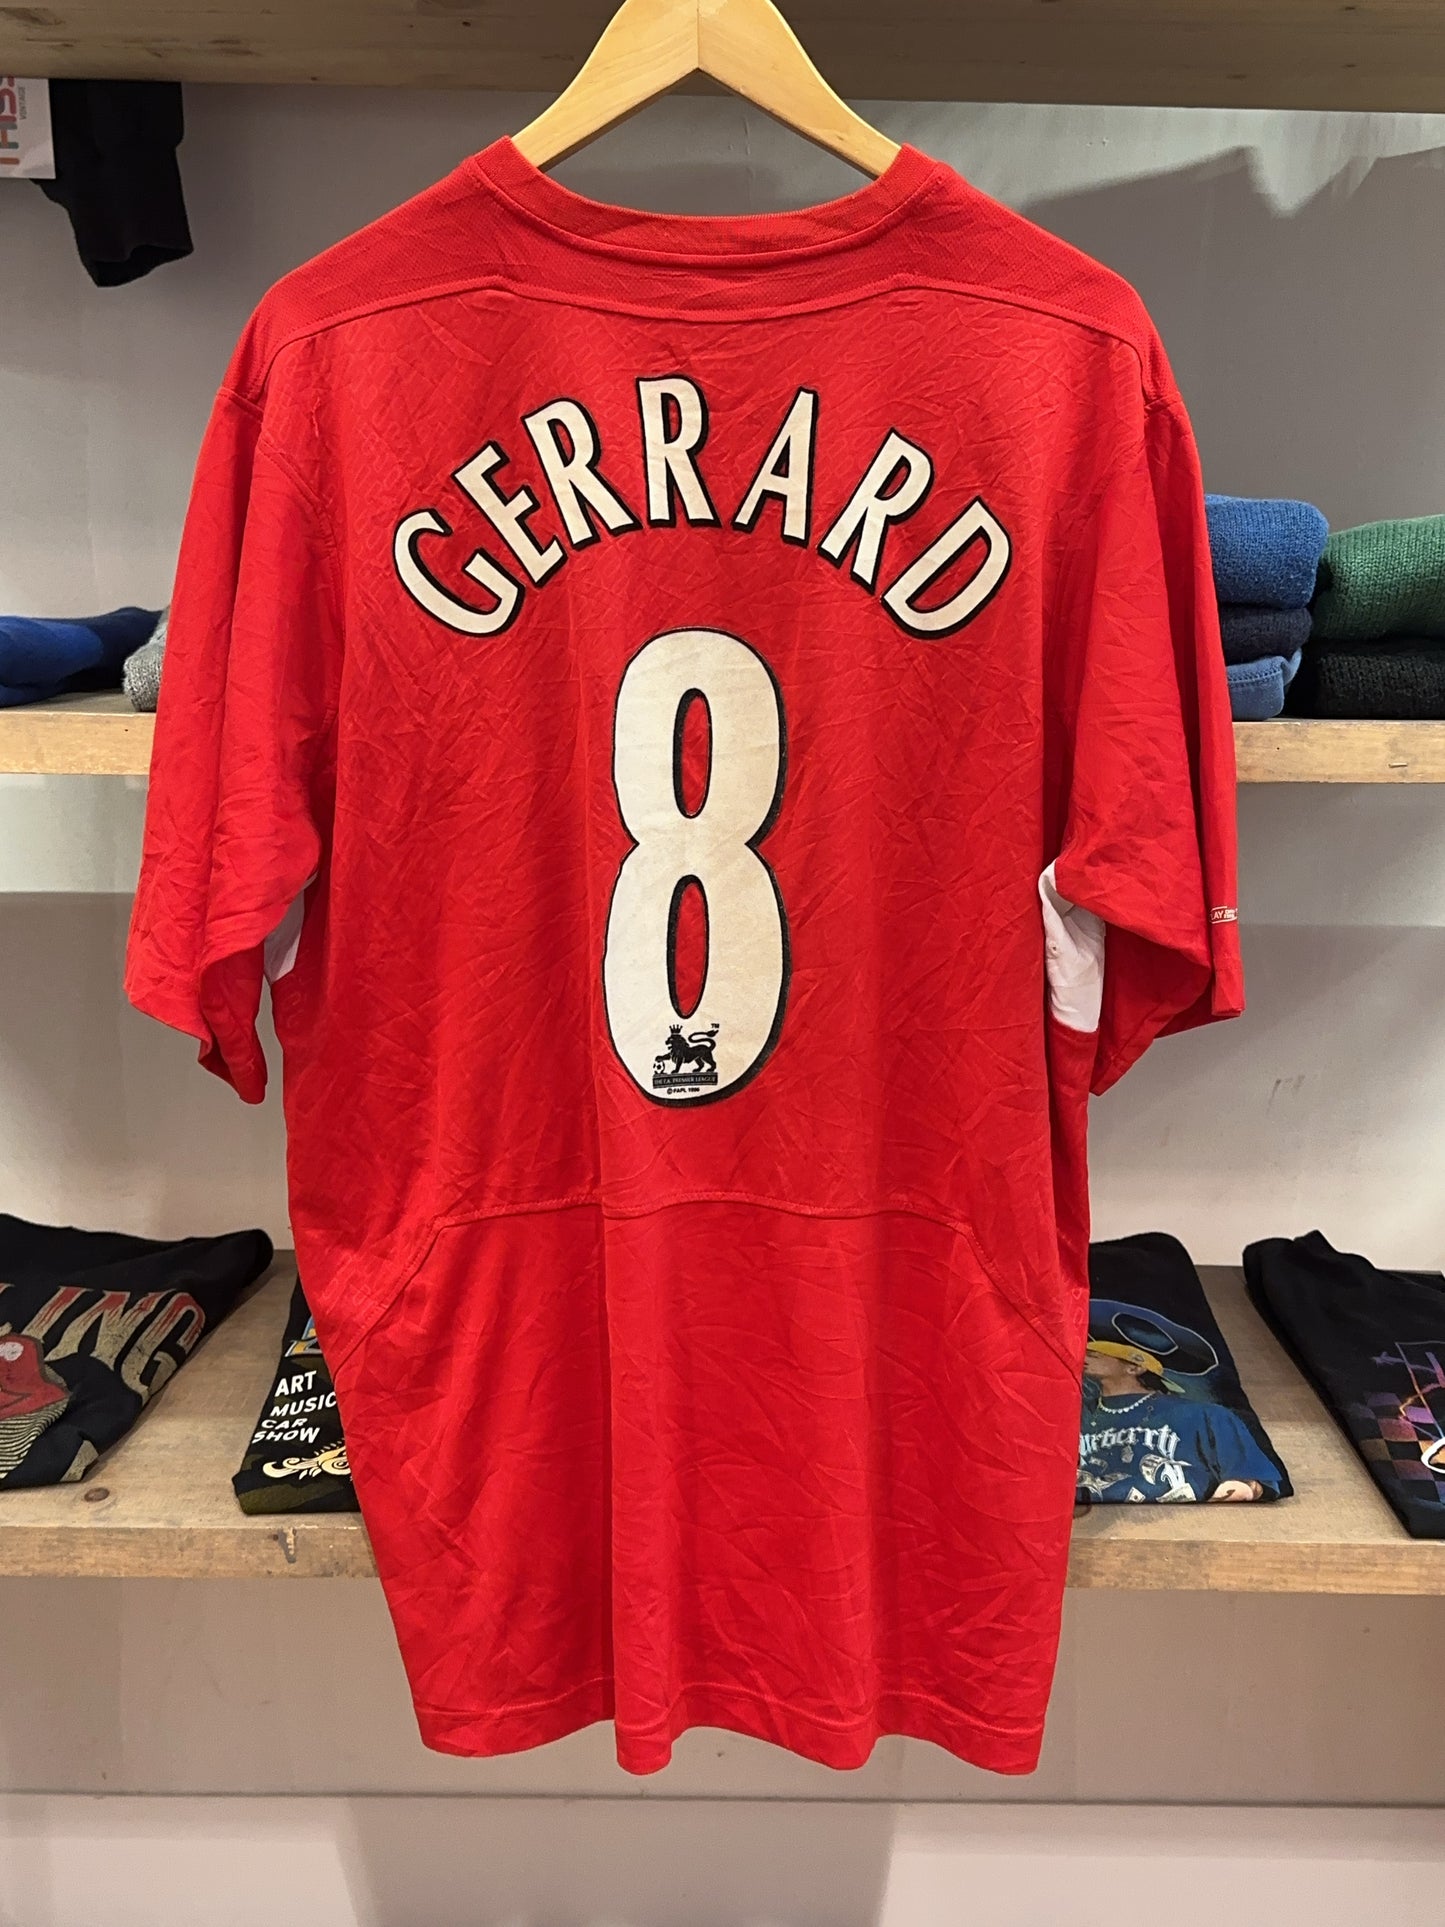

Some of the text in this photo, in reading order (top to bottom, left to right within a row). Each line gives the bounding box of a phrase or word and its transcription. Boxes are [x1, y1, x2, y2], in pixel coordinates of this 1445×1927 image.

[392, 376, 1012, 638] GERRARD
[603, 627, 790, 1108] 8
[274, 1370, 317, 1397] ART
[270, 1391, 337, 1417] MUSIC
[252, 1427, 320, 1444] SHOW
[261, 1418, 308, 1430] CAR
